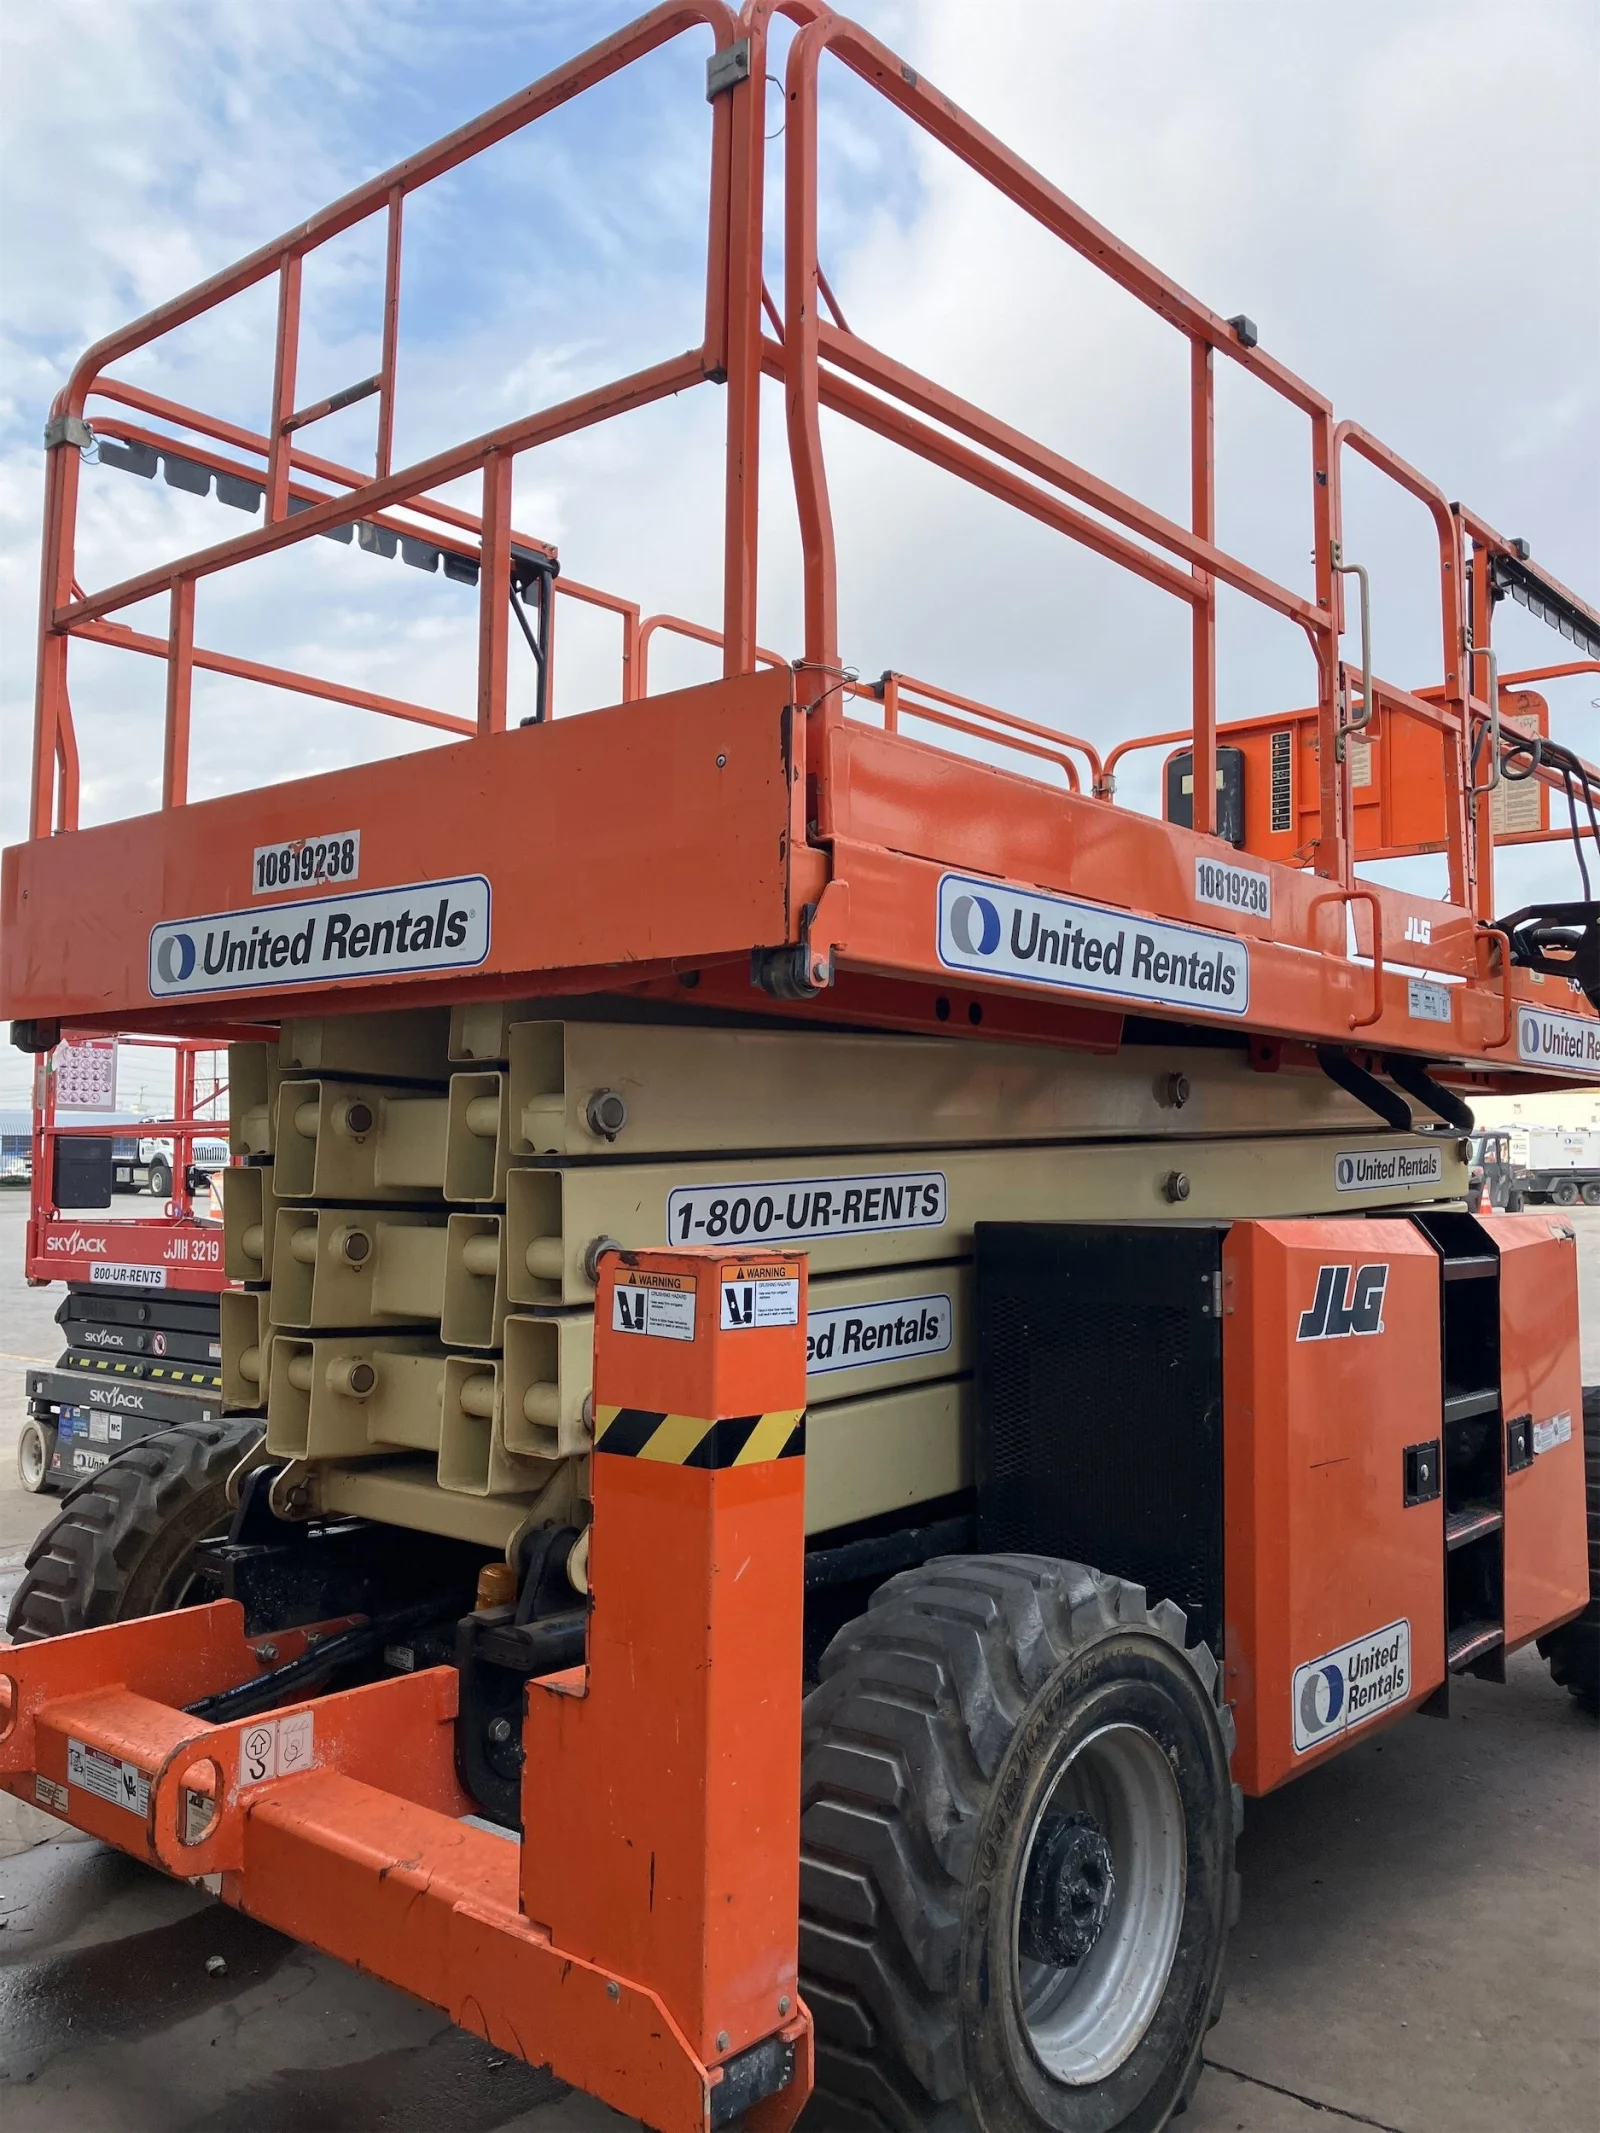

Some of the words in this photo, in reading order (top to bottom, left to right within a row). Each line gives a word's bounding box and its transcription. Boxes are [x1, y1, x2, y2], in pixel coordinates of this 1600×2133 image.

[256, 838, 355, 888] 10819238
[1197, 863, 1268, 913] 10819238
[202, 917, 316, 976] United
[321, 899, 469, 961] Rentals
[1404, 916, 1431, 945] JLG
[1010, 908, 1125, 976] United
[1131, 933, 1236, 996] Rentals
[1542, 1023, 1584, 1059] United
[1356, 1156, 1396, 1182] United
[1397, 1153, 1437, 1178] Rentals
[677, 1183, 940, 1240] 1-800-UR-RENTS
[46, 1229, 108, 1256] SKYJACK
[191, 1239, 220, 1262] 3219
[93, 1267, 162, 1284] 800-UR-RENTS
[638, 1273, 682, 1289] WARNING
[746, 1266, 786, 1279] WARNING
[1296, 1263, 1389, 1342] JLG
[84, 1328, 124, 1346] SKYJACK
[841, 1308, 940, 1355] Rentals
[89, 1386, 144, 1410] SKYJACK
[1347, 1634, 1400, 1683] United
[1347, 1664, 1404, 1714] Rentals
